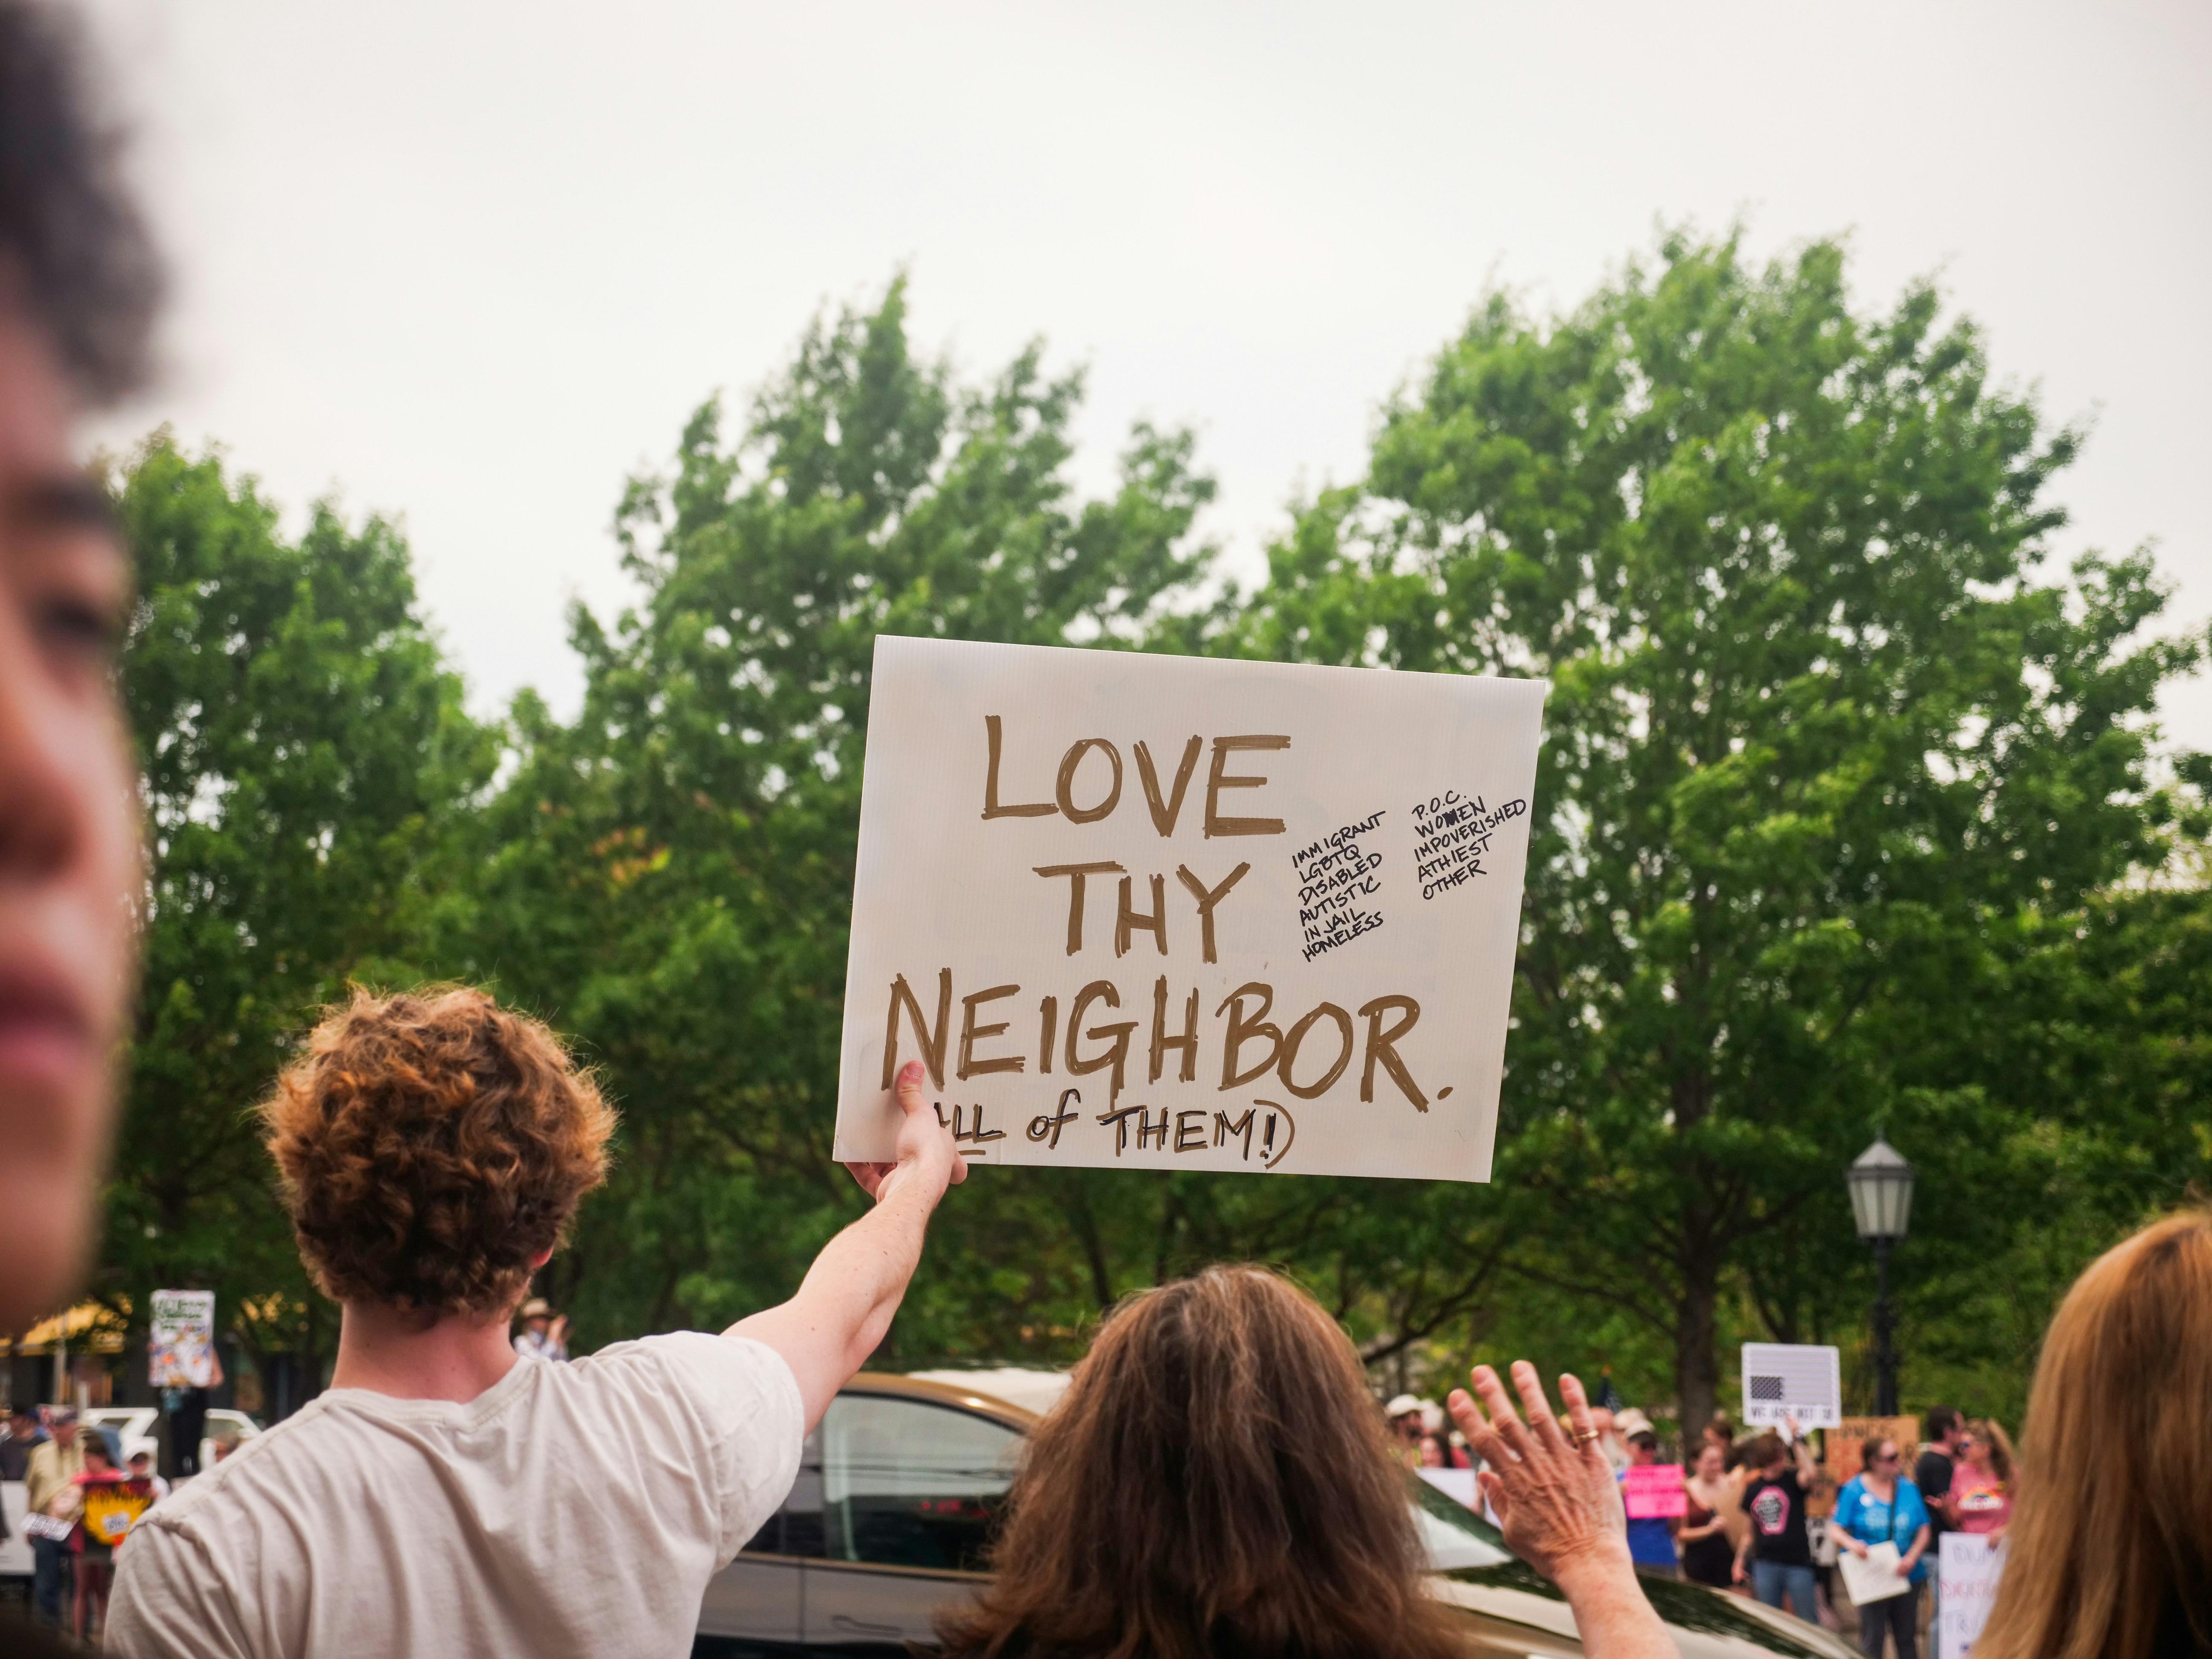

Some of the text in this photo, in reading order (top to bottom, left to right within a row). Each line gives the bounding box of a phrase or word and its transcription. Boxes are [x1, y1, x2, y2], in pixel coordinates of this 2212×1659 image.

[981, 715, 1291, 840] LOVE
[1412, 790, 1467, 821] P.O.C.
[1414, 799, 1526, 862] IMPOVERISHED
[1415, 796, 1486, 838] WOMEN
[1292, 810, 1386, 868] IMMIGRANT
[1299, 844, 1361, 883] LGBTQ
[1418, 833, 1493, 883] ATHIEST
[1298, 853, 1382, 906] DISABLED
[1300, 875, 1381, 927] AUTISTIC
[1423, 859, 1487, 900] OTHER
[1032, 861, 1251, 964] THY
[1302, 911, 1383, 963] HOMELESS
[1304, 908, 1366, 943] IN JAIL
[881, 967, 1453, 1114] NEIGHBOR.
[1026, 1089, 1081, 1150] of
[1096, 1100, 1295, 1170] THEM!)
[1751, 1407, 1767, 1419] WE
